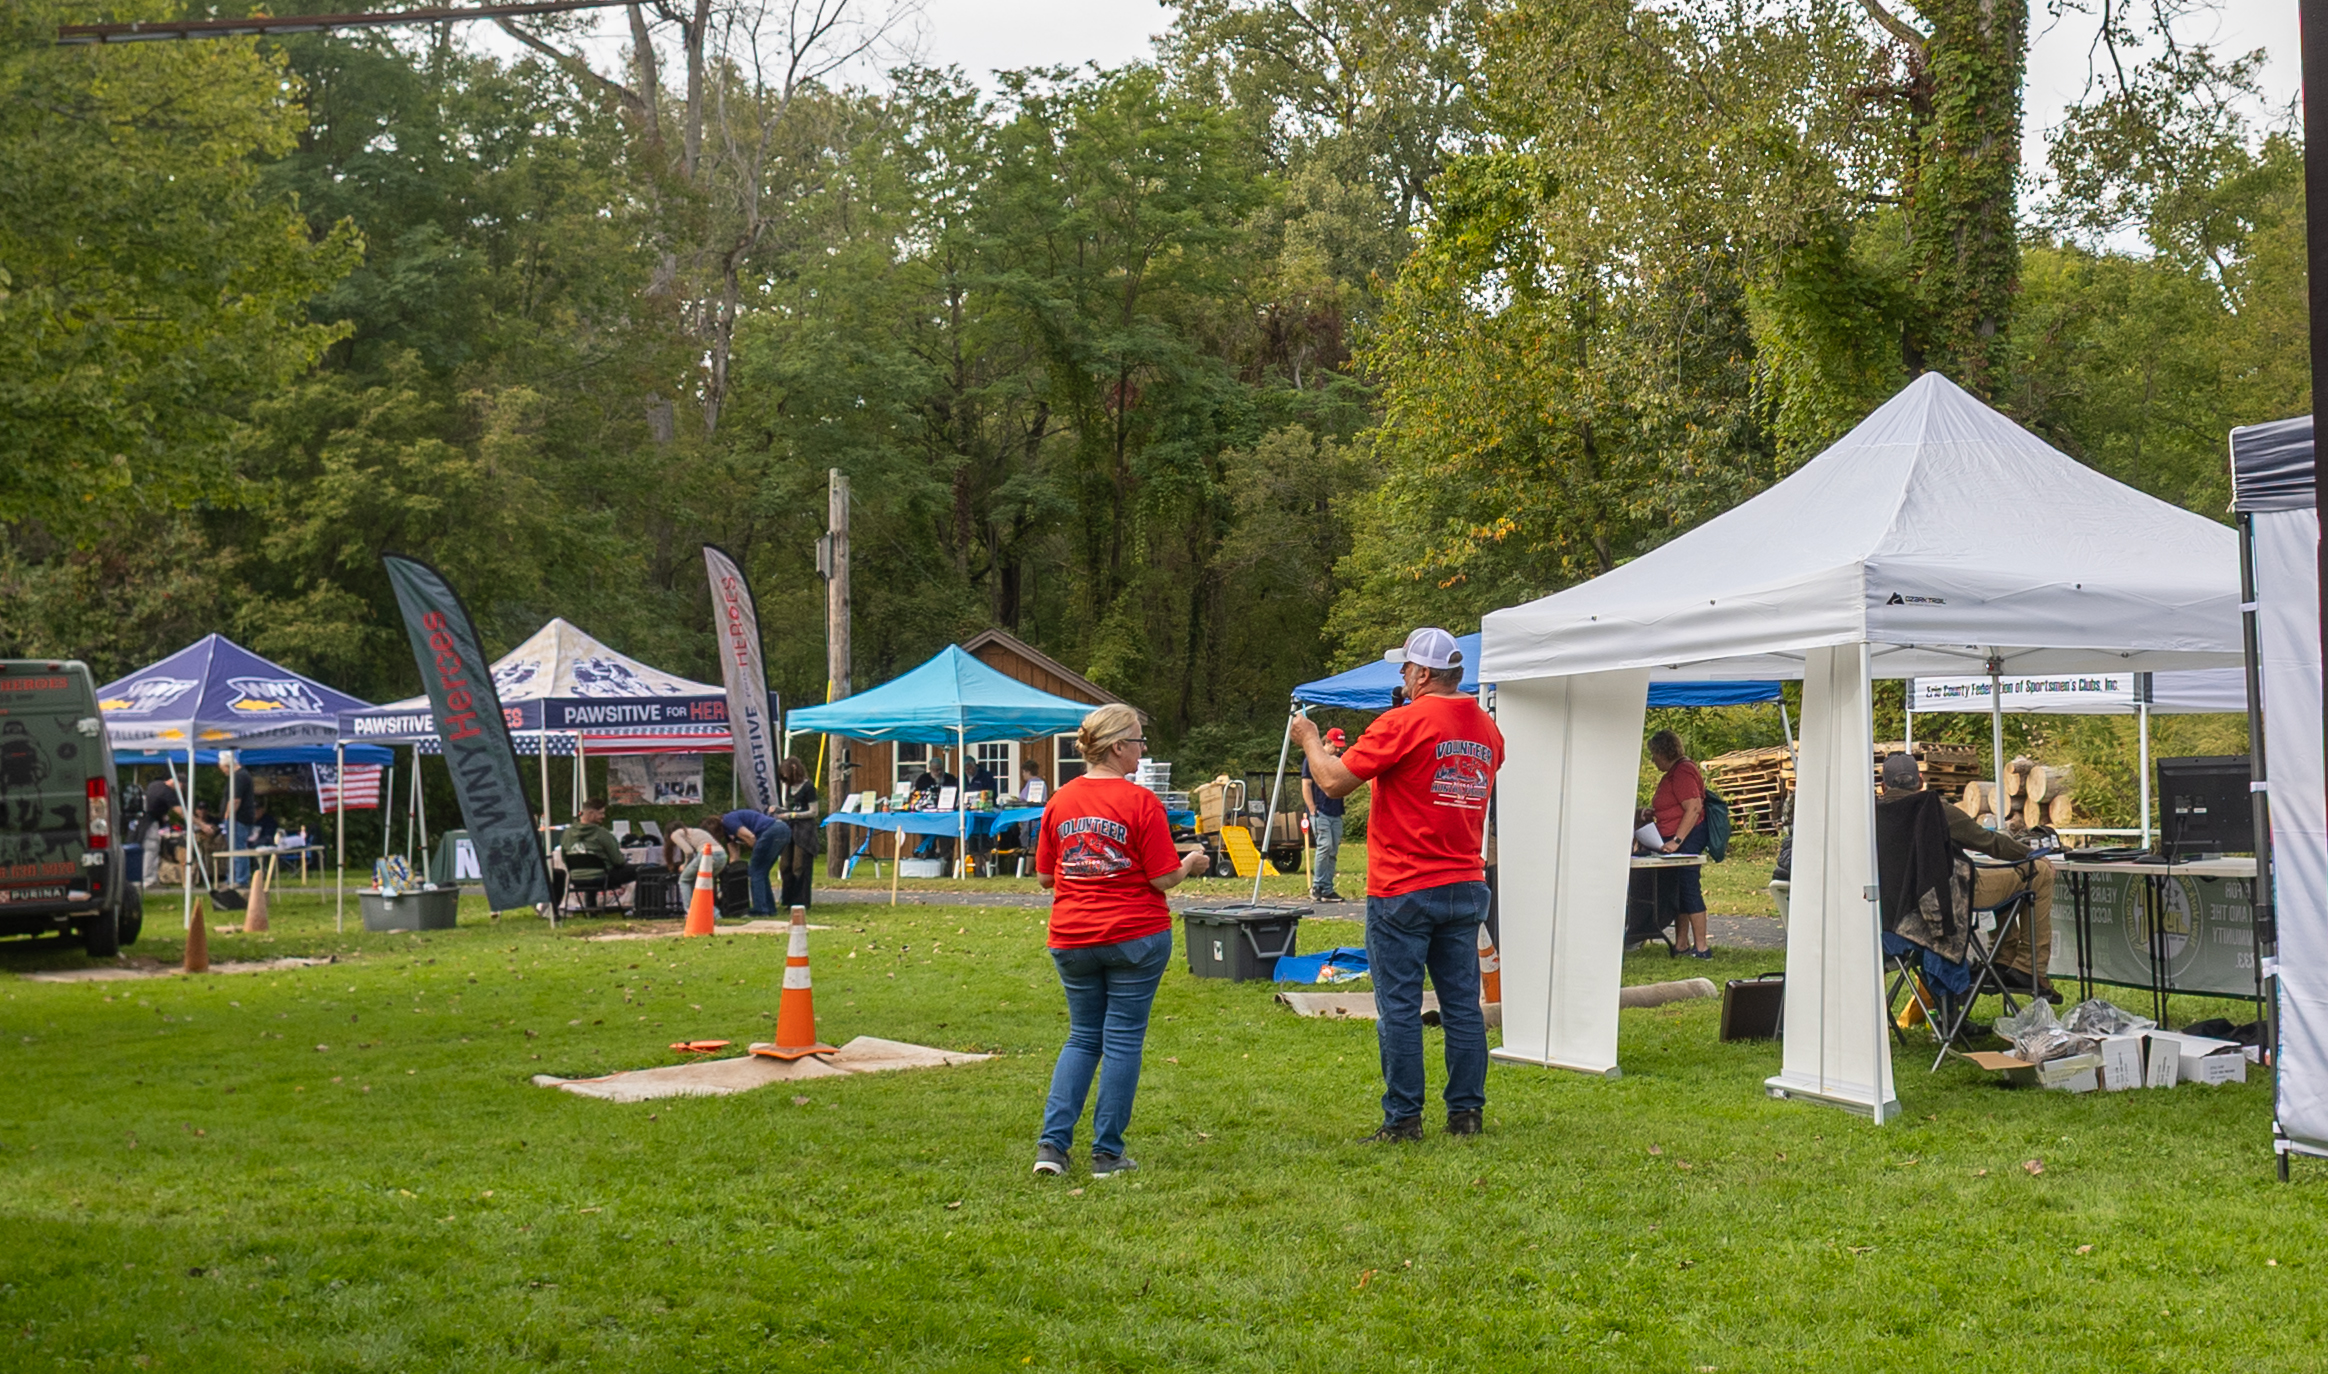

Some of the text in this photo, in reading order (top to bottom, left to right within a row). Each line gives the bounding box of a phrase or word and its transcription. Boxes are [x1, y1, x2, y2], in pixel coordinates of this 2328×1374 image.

[721, 576, 748, 667] HEROES
[0, 677, 69, 691] HEROES
[423, 611, 481, 742] Heroes
[236, 682, 301, 698] WNY
[1925, 686, 1942, 698] Erie
[1943, 684, 1970, 698] County
[1971, 681, 2014, 696] Federtion
[2015, 680, 2024, 693] of
[2026, 678, 2077, 695] Sportsmen's
[2105, 677, 2120, 691] Inc.
[564, 701, 730, 724] PAWSITIVE FOR HER
[354, 714, 434, 734] PAWSITIVE
[451, 744, 507, 832] WNY
[11, 888, 62, 900] PURINA
